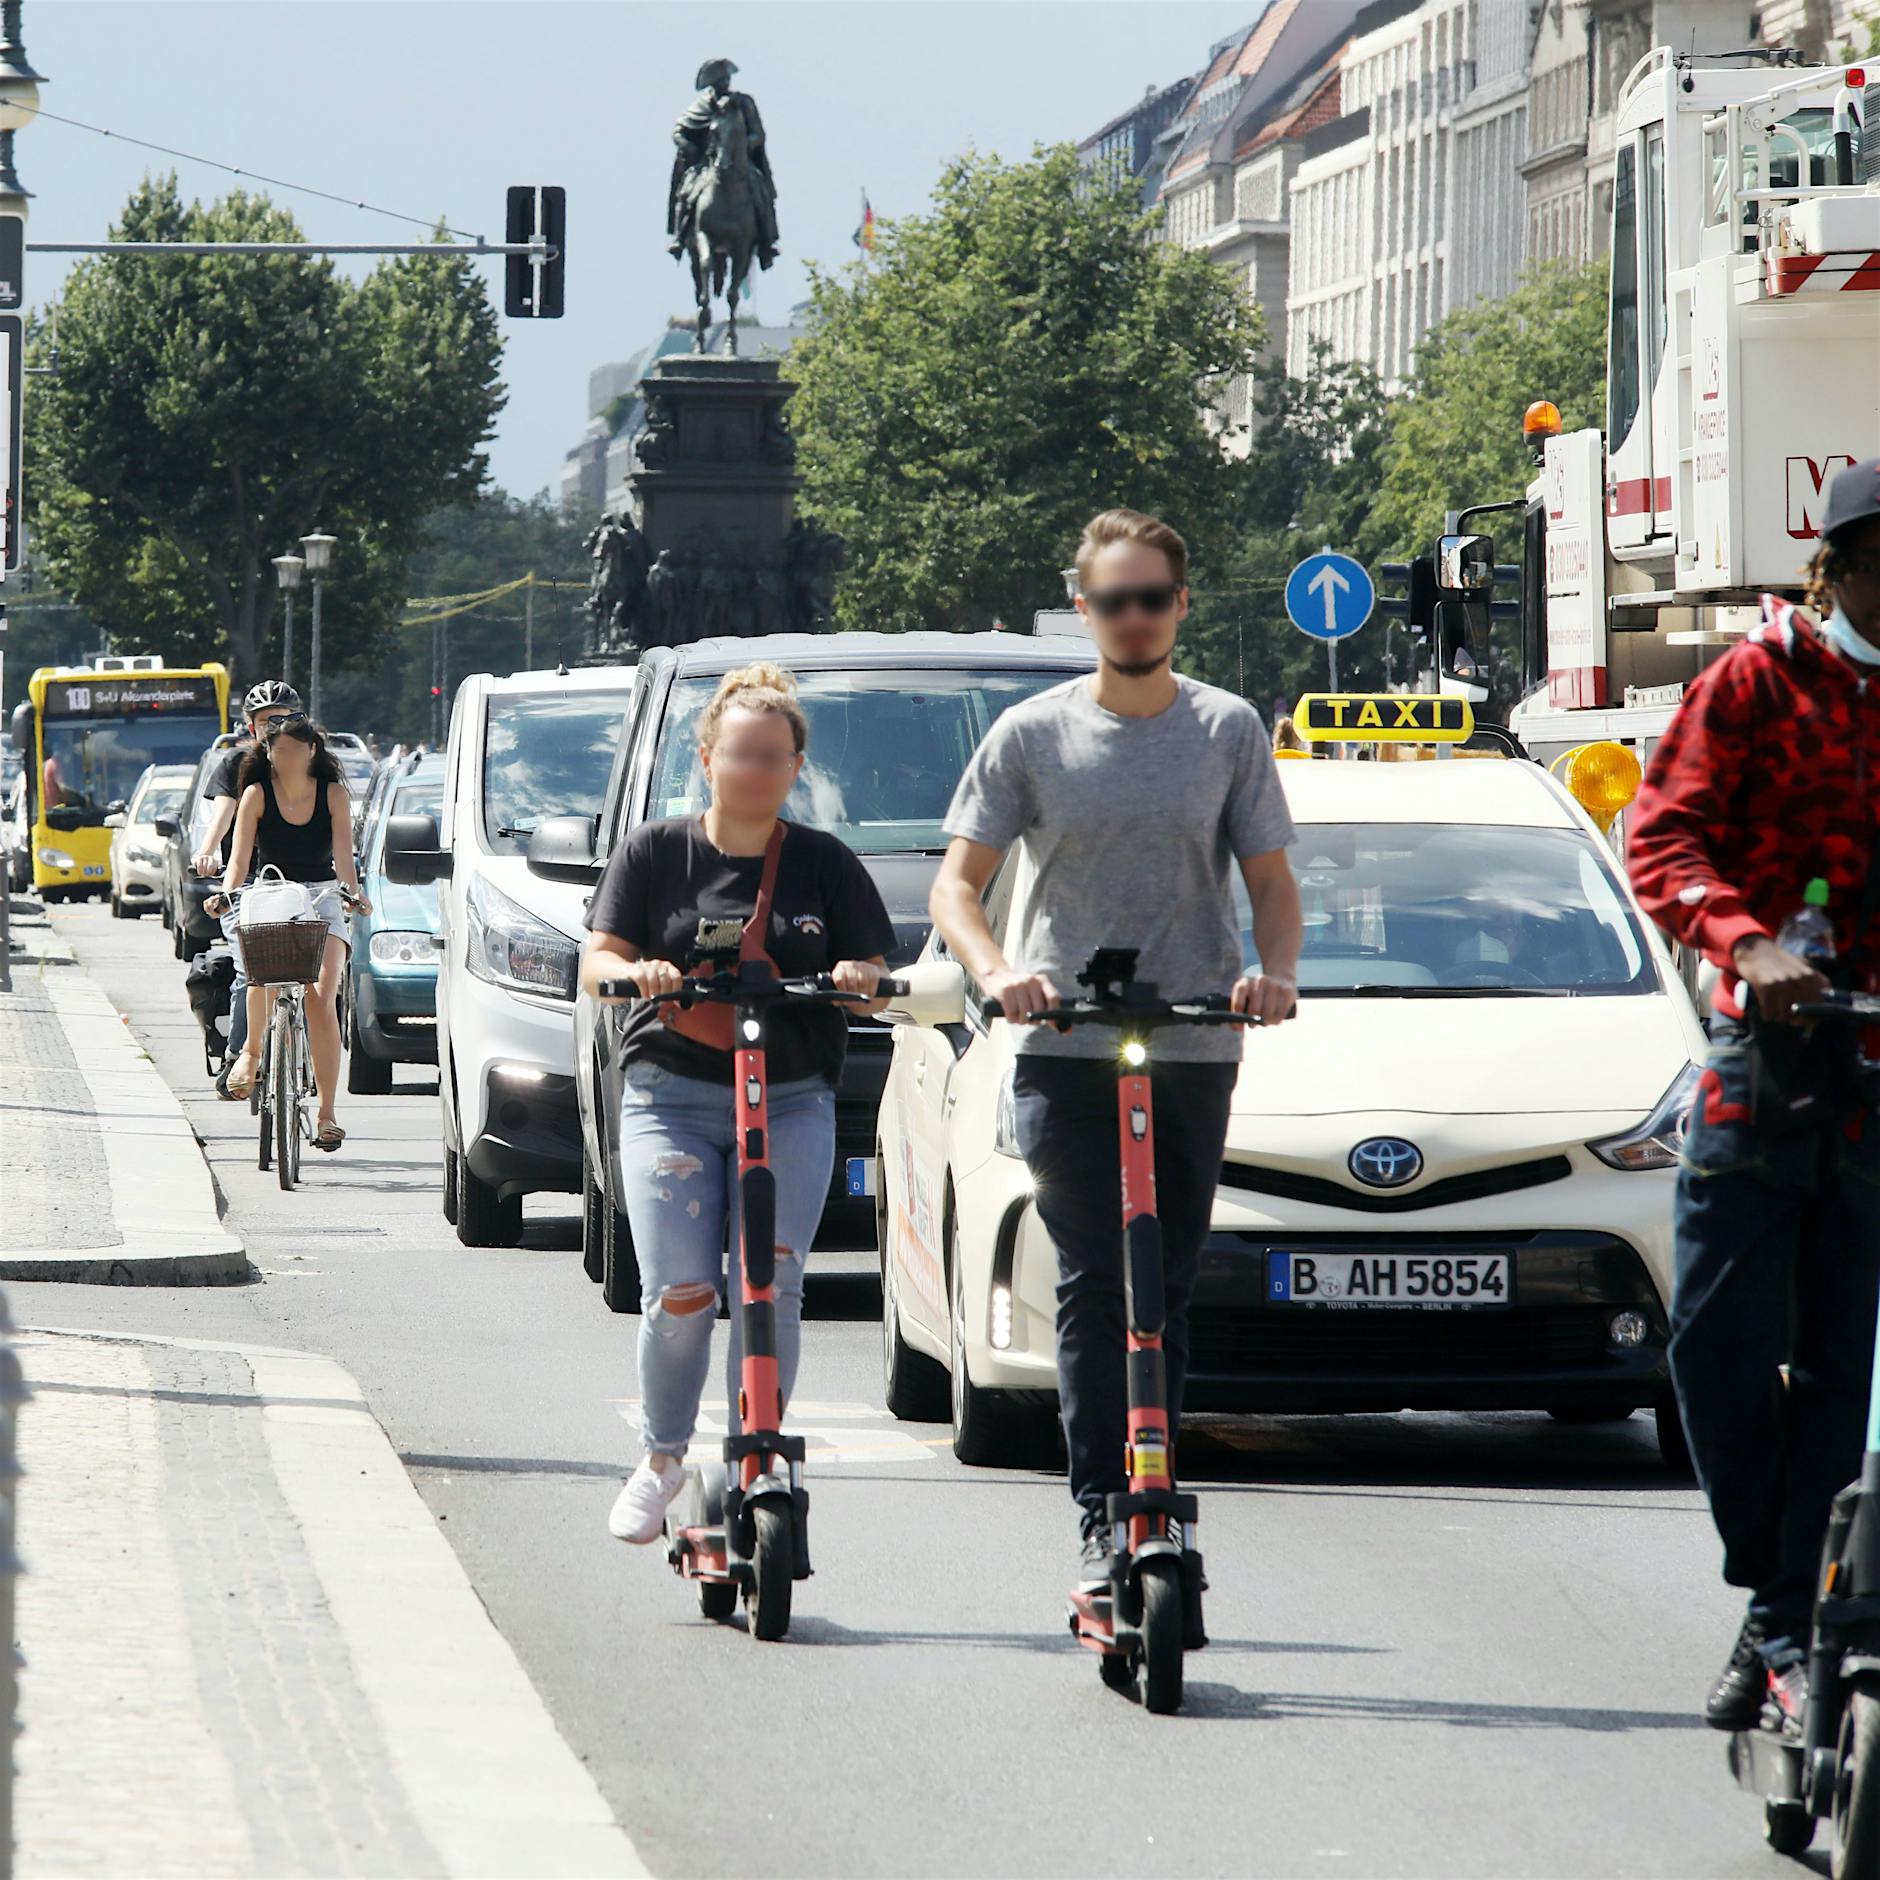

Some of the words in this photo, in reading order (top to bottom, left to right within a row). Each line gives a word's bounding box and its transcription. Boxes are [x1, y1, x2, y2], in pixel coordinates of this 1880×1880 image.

[65, 687, 92, 711] 100
[1327, 700, 1442, 727] TAXI
[853, 1181, 860, 1190] D
[1294, 1258, 1318, 1295] B
[1274, 1281, 1283, 1292] D
[1327, 1302, 1359, 1310] TOYOTA
[1422, 1303, 1452, 1311] BERLIN
